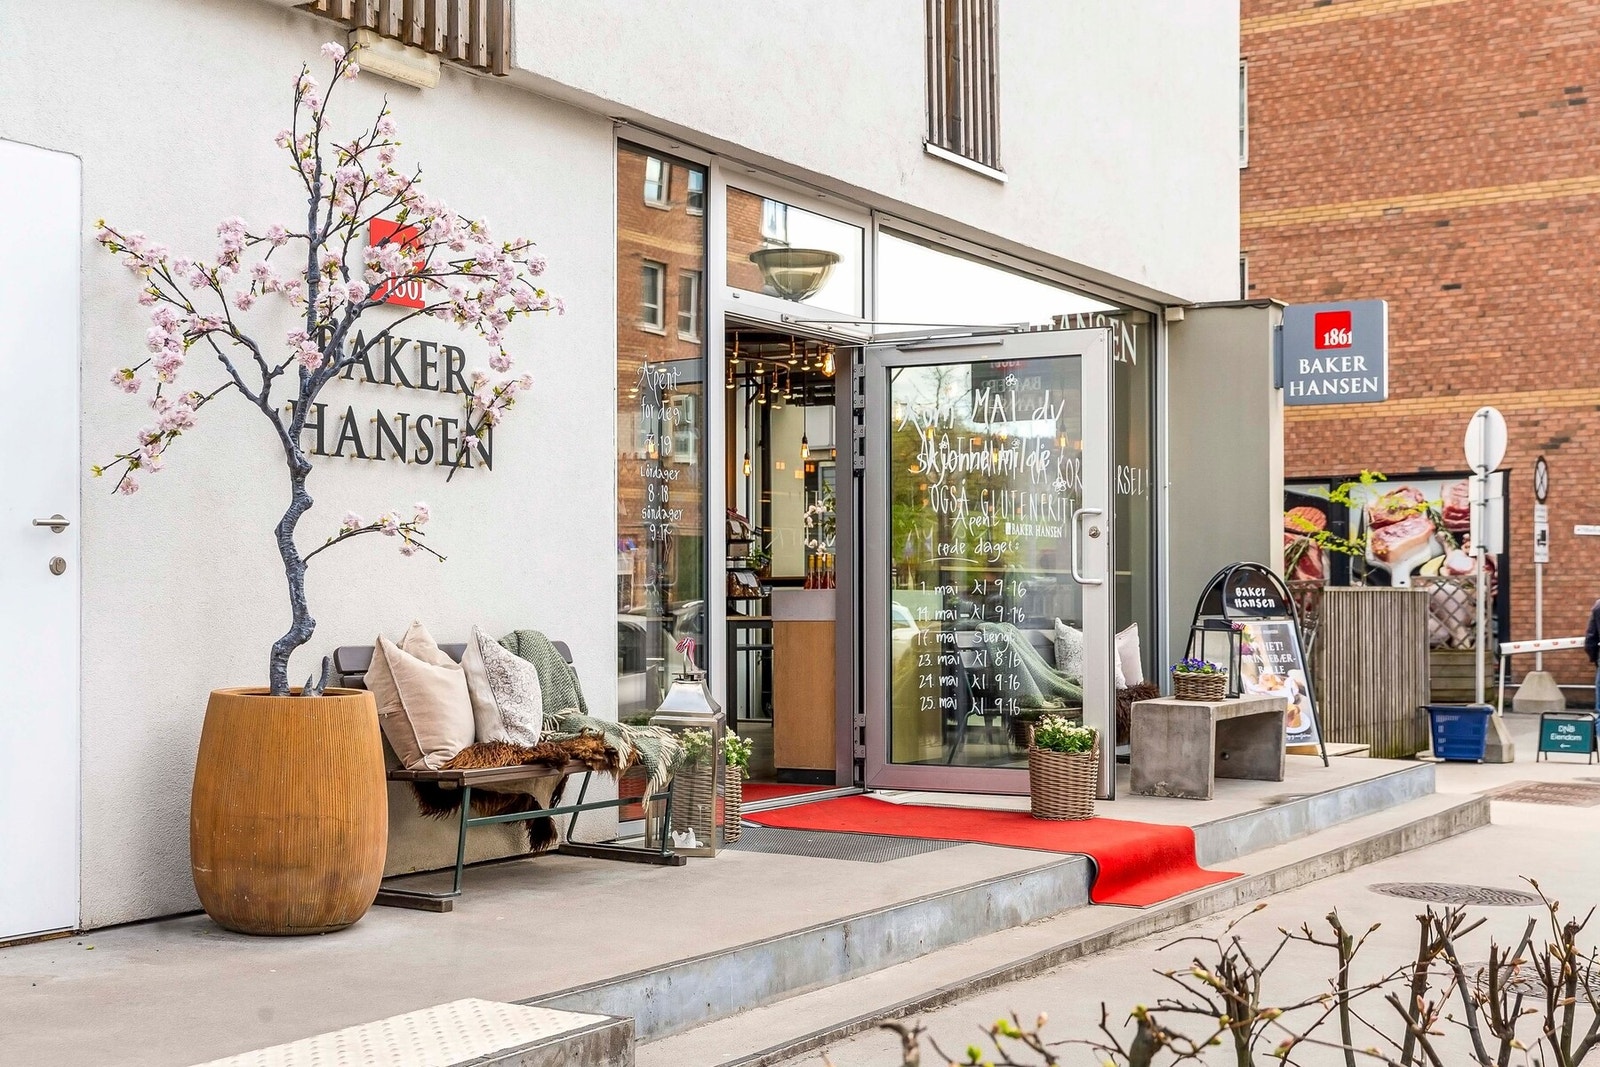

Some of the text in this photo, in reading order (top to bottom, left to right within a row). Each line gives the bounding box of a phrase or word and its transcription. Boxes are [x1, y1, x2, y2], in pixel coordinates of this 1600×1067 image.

[1323, 328, 1352, 346] 1861
[1299, 355, 1368, 374] BAKER
[1289, 376, 1379, 397] HANSEN
[640, 395, 680, 426] for deg
[970, 386, 1017, 428] MAI
[1011, 522, 1062, 538] BAKER HANSEN
[934, 581, 958, 596] mai
[934, 605, 958, 621] mai
[936, 627, 958, 645] mai
[937, 651, 960, 666] mai
[938, 669, 959, 688] mai
[938, 693, 958, 710] mai
[1550, 732, 1583, 741] Eiendom
